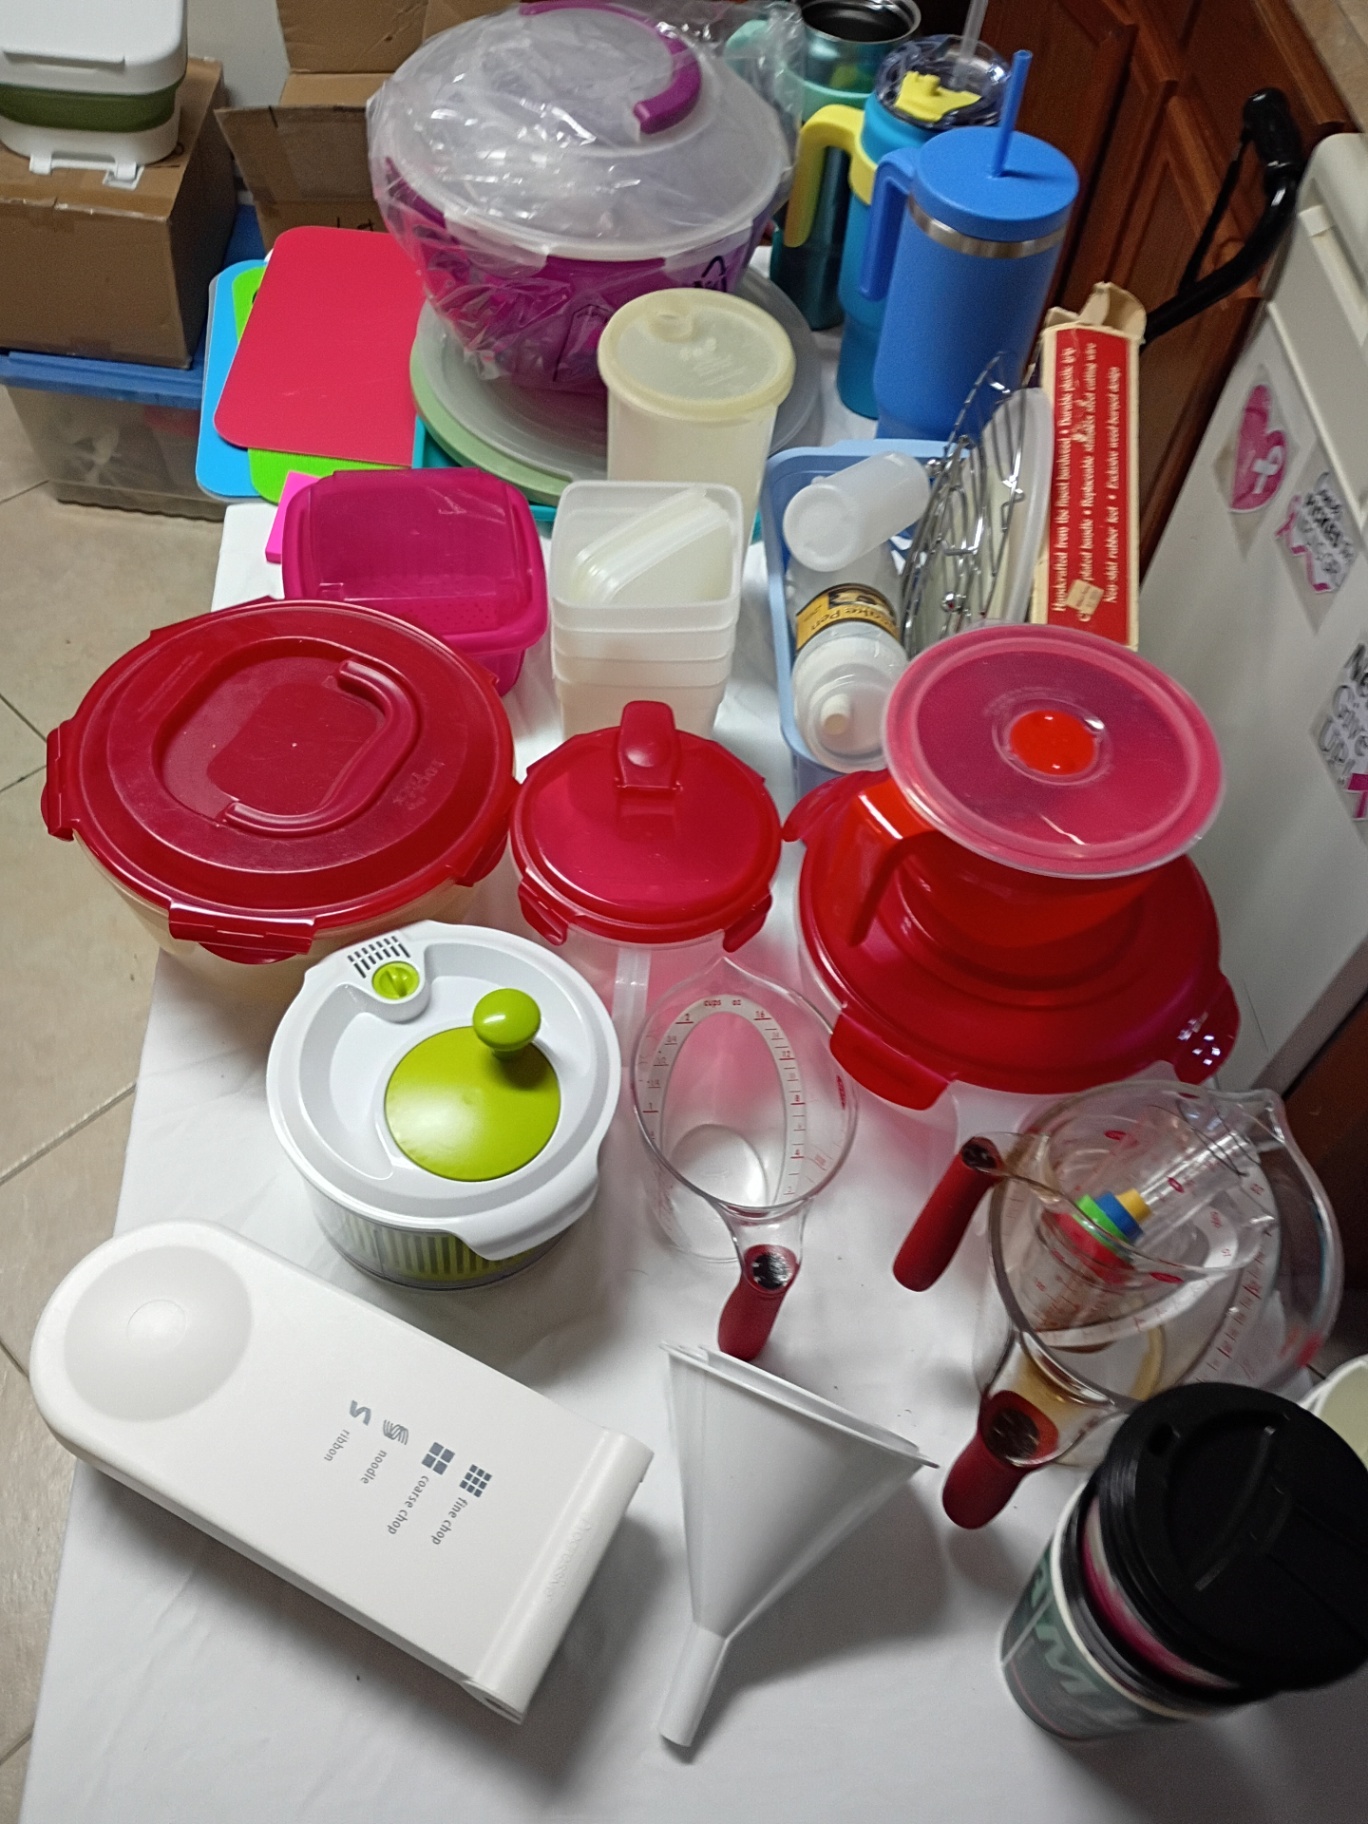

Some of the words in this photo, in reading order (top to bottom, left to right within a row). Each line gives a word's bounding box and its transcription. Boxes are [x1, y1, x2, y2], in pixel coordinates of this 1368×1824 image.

[1080, 519, 1095, 549] handle
[1105, 527, 1119, 558] rubber
[1051, 553, 1068, 612] Handcrafted
[703, 998, 722, 1009] cups
[324, 1429, 350, 1462] ribbon
[359, 1449, 388, 1484] noodle
[404, 1475, 430, 1508] coarse
[387, 1509, 408, 1535] chop
[448, 1497, 468, 1519] fine
[431, 1519, 452, 1545] chop
